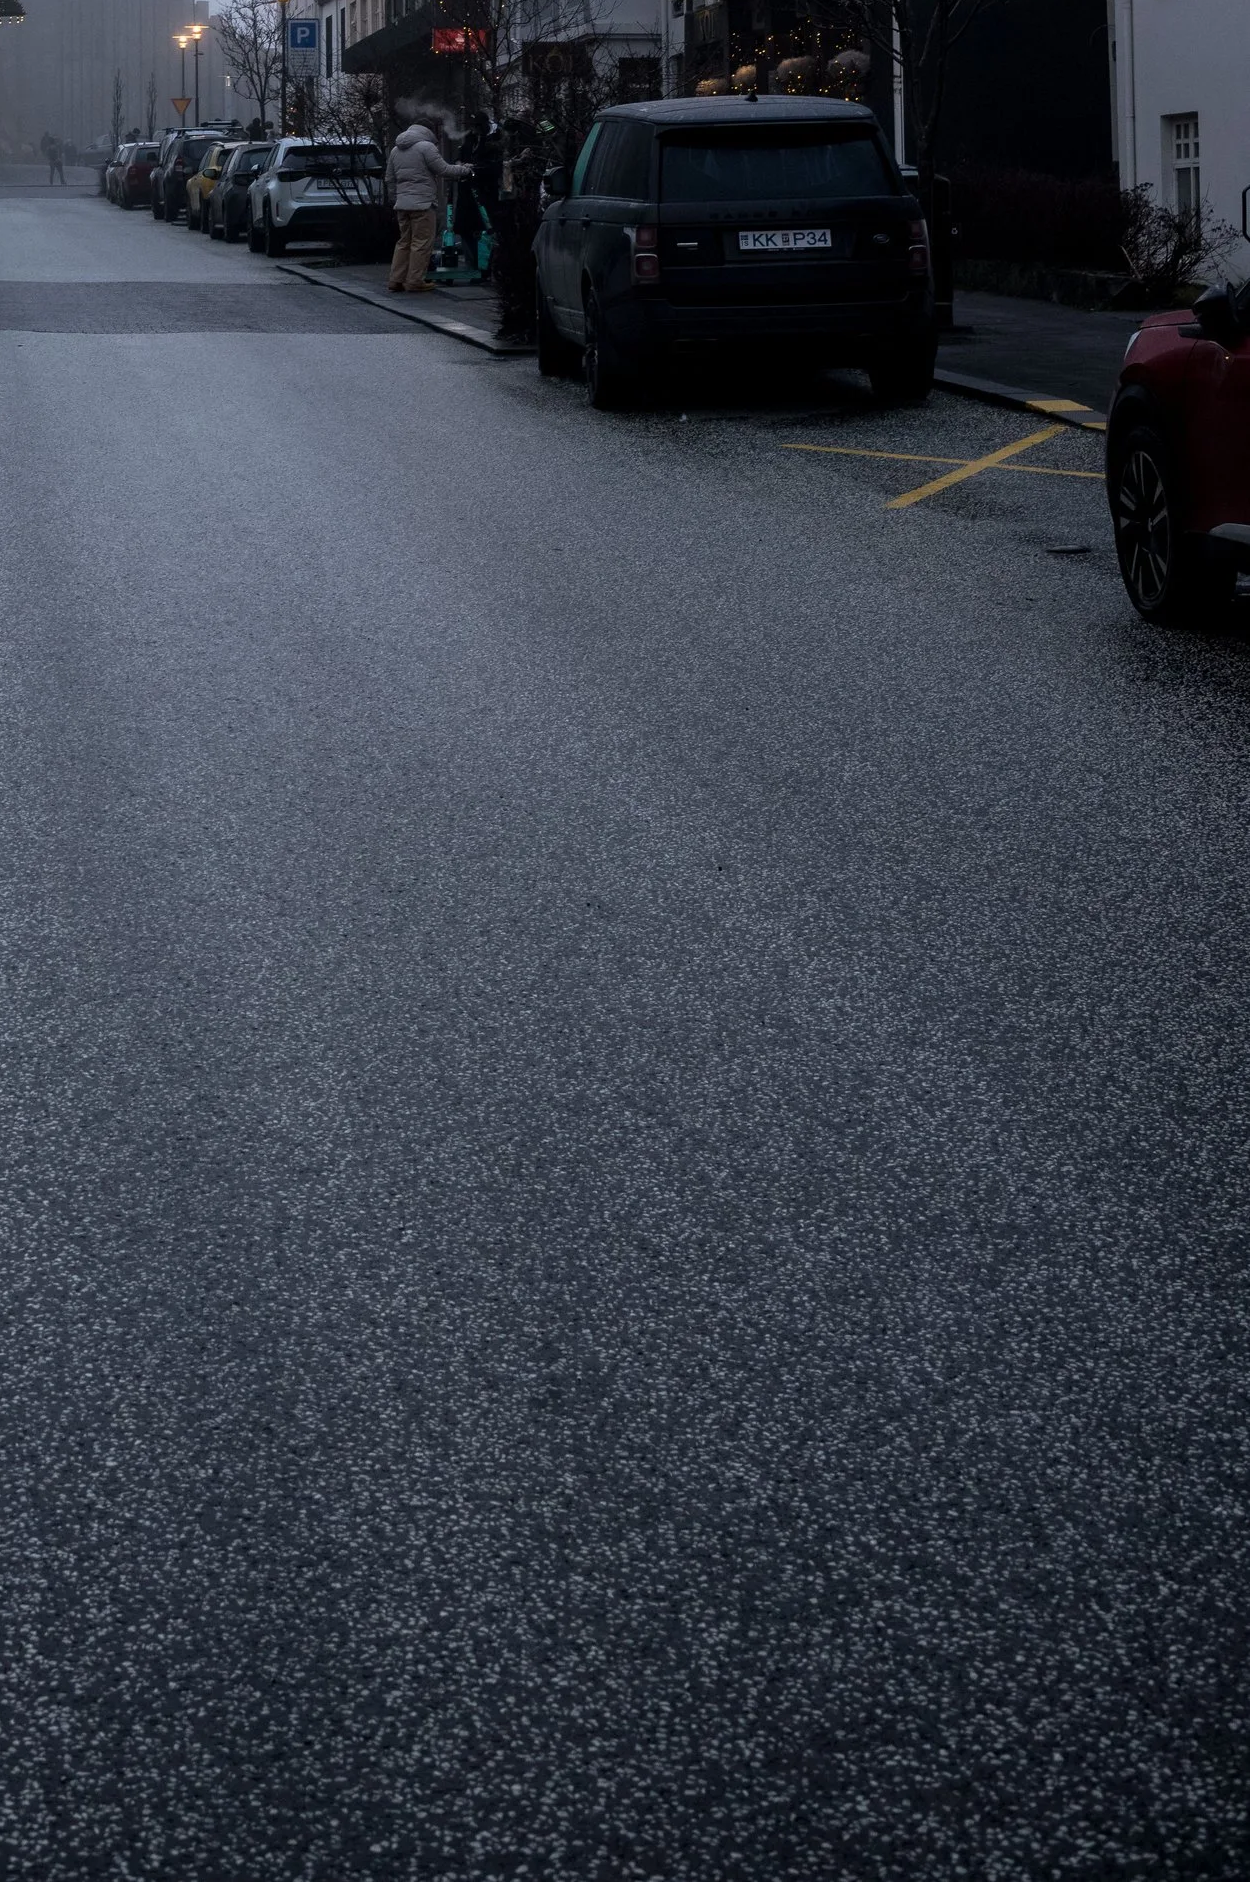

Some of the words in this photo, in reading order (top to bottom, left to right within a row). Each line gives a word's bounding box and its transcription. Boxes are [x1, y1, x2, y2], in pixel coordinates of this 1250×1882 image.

[296, 27, 310, 44] P
[753, 233, 778, 247] KK
[793, 231, 828, 246] P34
